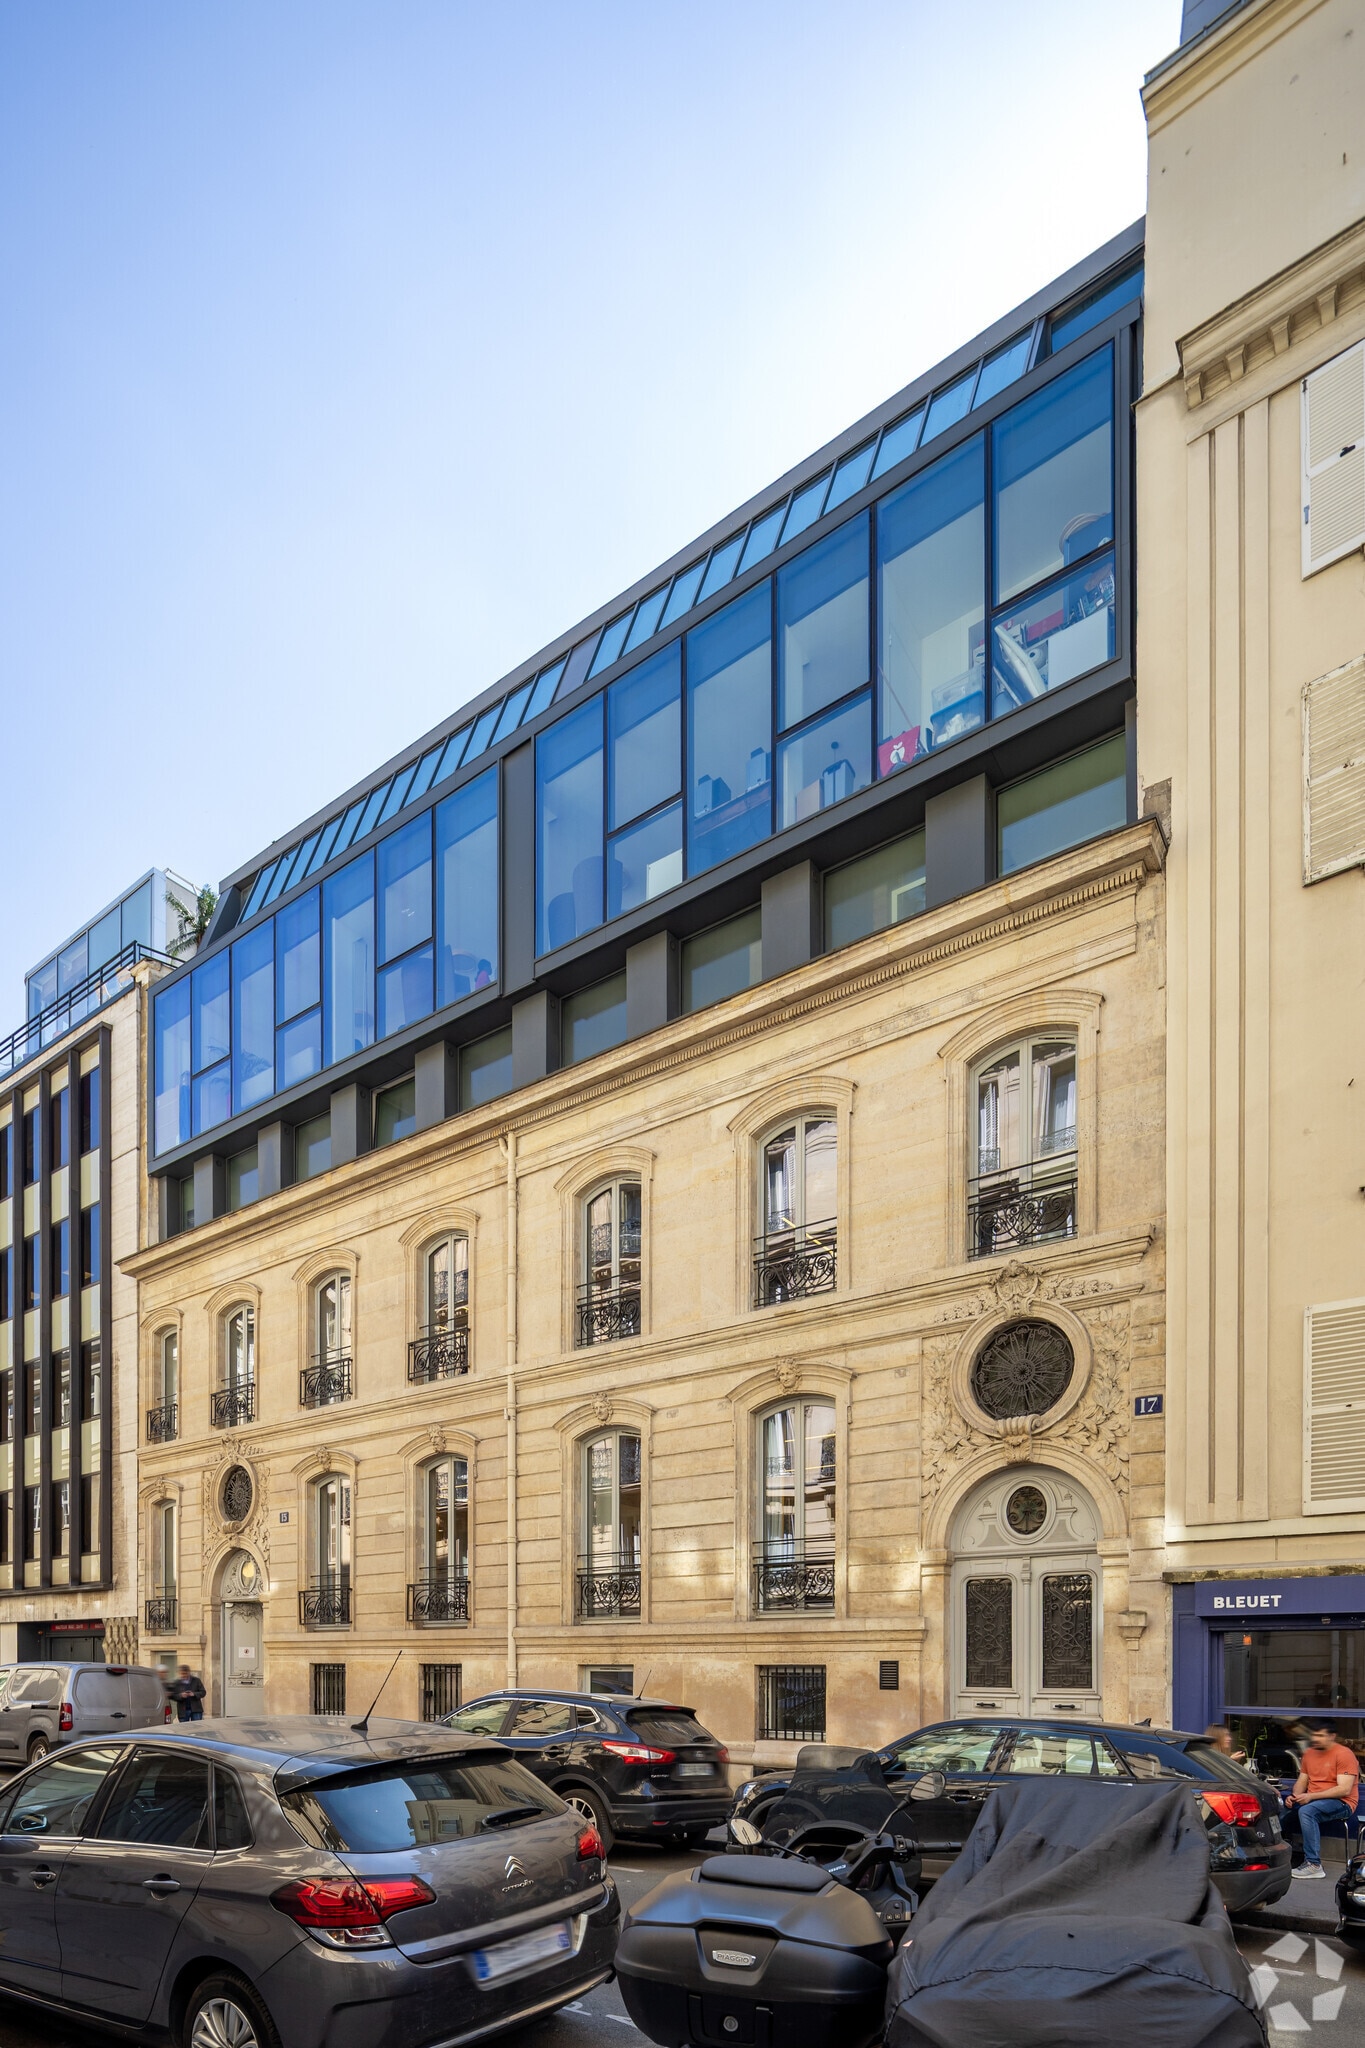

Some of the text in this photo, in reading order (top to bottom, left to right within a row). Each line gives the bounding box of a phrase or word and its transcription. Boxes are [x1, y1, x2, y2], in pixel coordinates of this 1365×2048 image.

[1140, 1396, 1158, 1413] 17
[281, 1512, 288, 1522] 15
[1213, 1594, 1282, 1608] BLEUET
[717, 1952, 749, 1963] PIAGGIO
